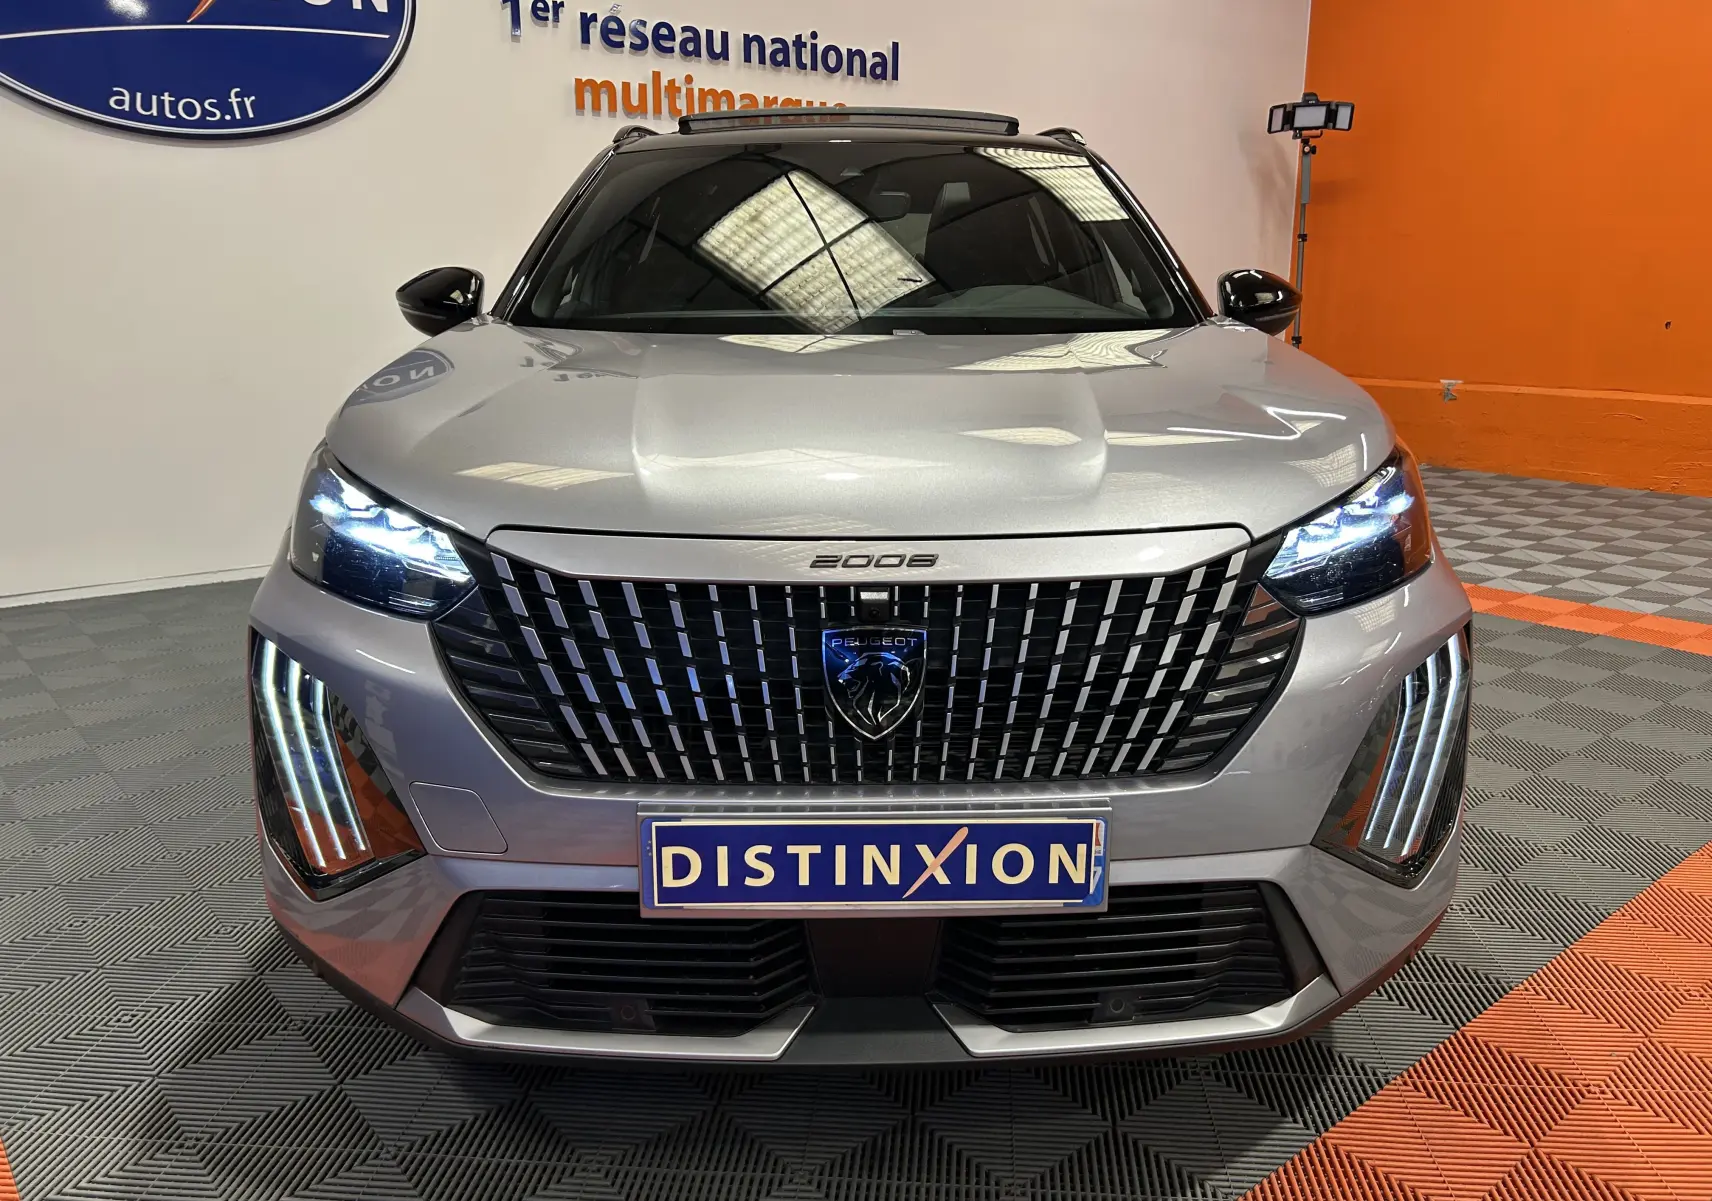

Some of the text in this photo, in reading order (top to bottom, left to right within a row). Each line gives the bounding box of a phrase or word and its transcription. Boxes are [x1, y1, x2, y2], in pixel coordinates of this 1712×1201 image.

[579, 3, 730, 62] réseau
[743, 30, 900, 81] national
[109, 86, 256, 121] autos.fr
[809, 553, 939, 568] 2008
[831, 636, 918, 648] PEUGEOT
[661, 828, 1087, 898] DISTINXION
